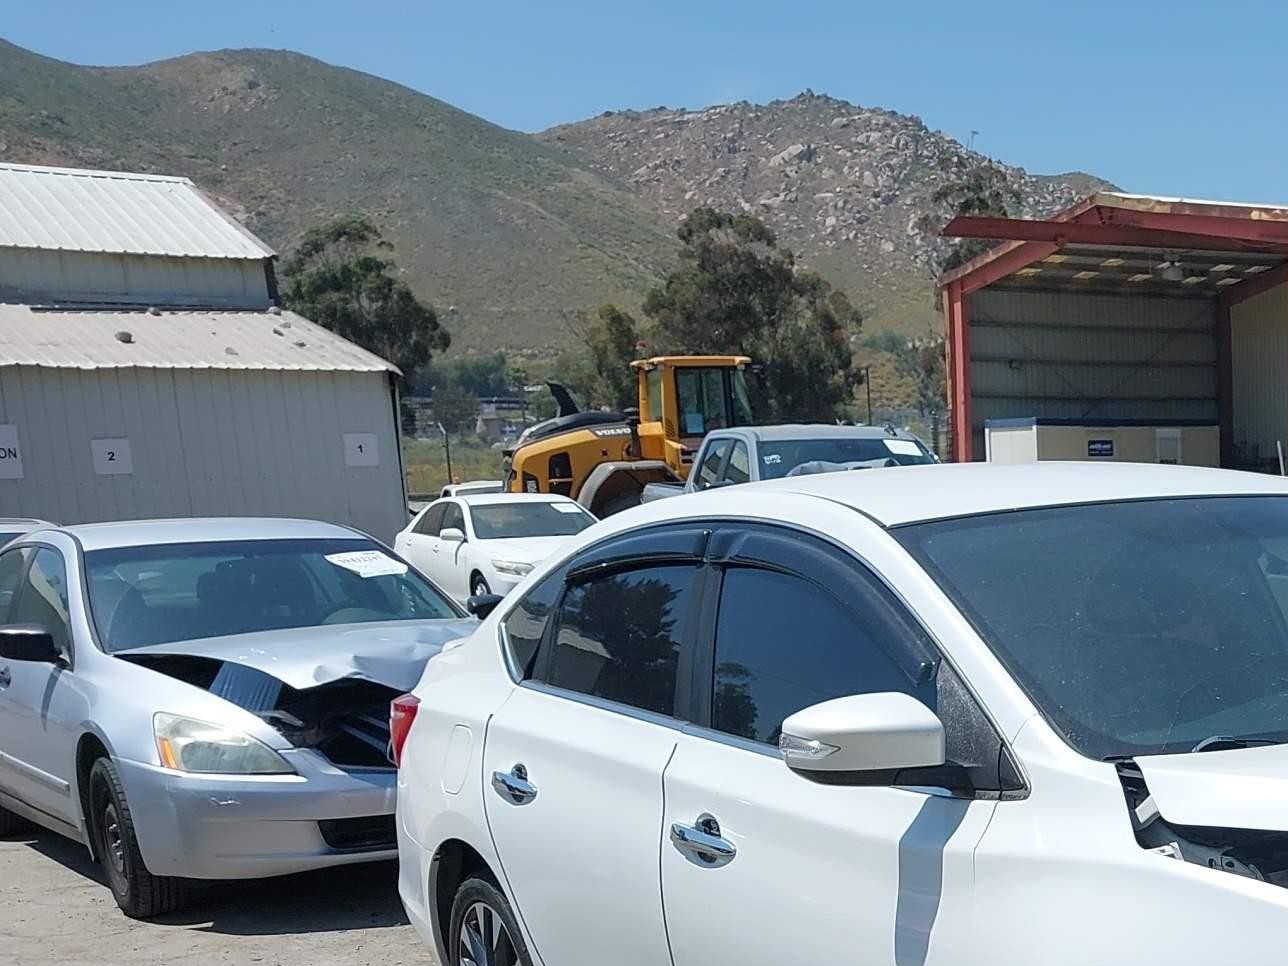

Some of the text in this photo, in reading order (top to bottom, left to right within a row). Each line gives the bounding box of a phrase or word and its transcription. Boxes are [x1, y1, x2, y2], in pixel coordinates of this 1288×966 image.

[595, 426, 632, 437] VOLVO
[357, 443, 364, 454] 1
[106, 451, 117, 462] 2
